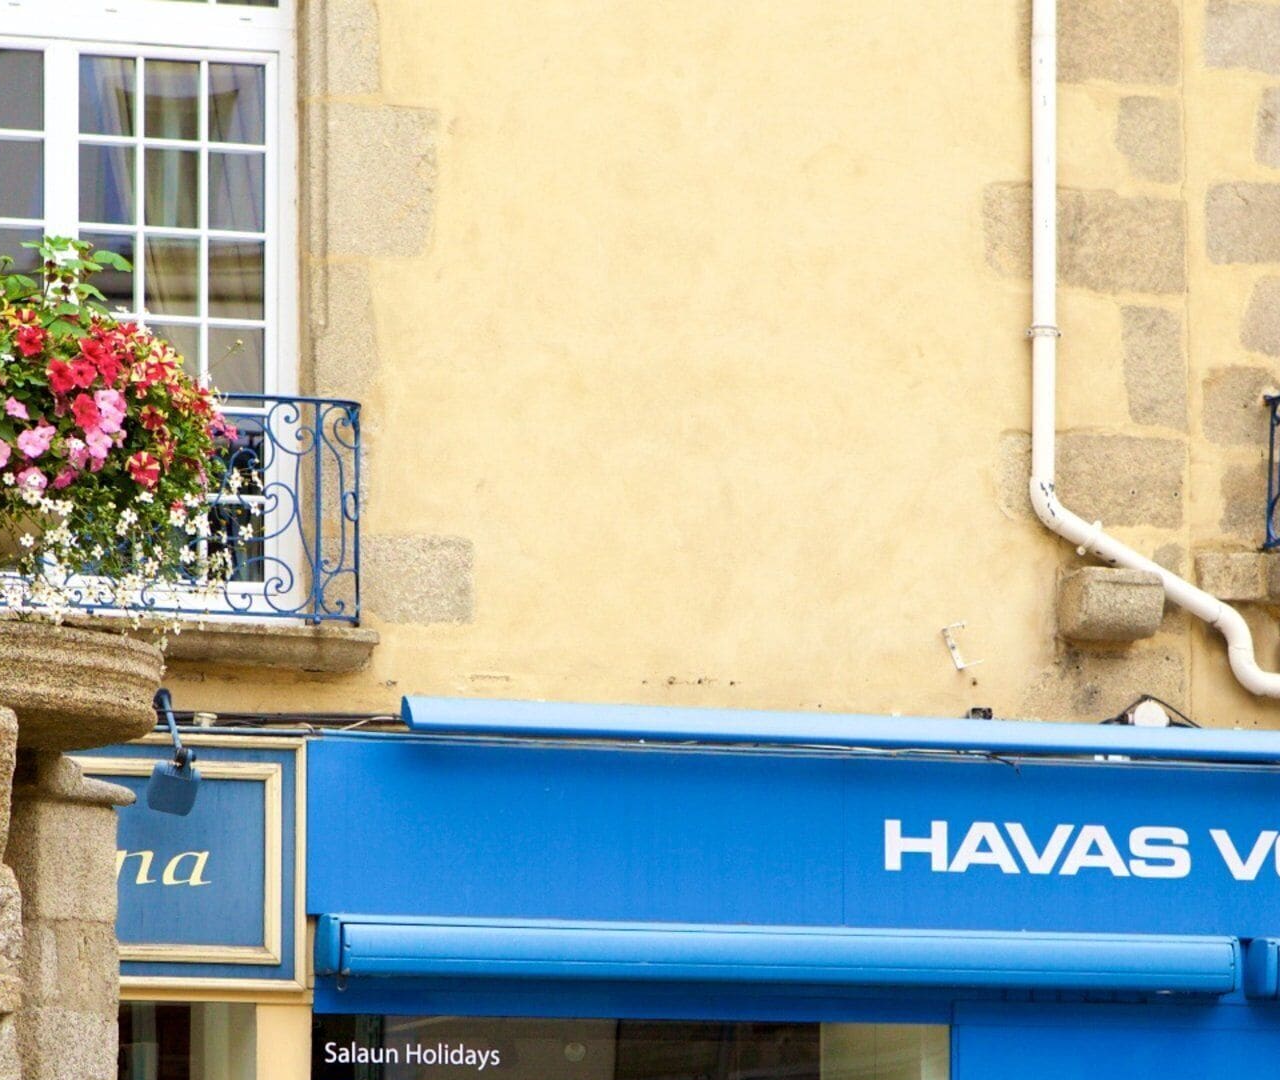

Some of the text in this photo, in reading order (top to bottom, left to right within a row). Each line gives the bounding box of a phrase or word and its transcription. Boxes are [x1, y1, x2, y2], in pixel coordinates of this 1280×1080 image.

[883, 818, 1191, 878] HAVAS
[116, 850, 214, 886] na
[324, 1041, 501, 1071] Salaun Holidays
